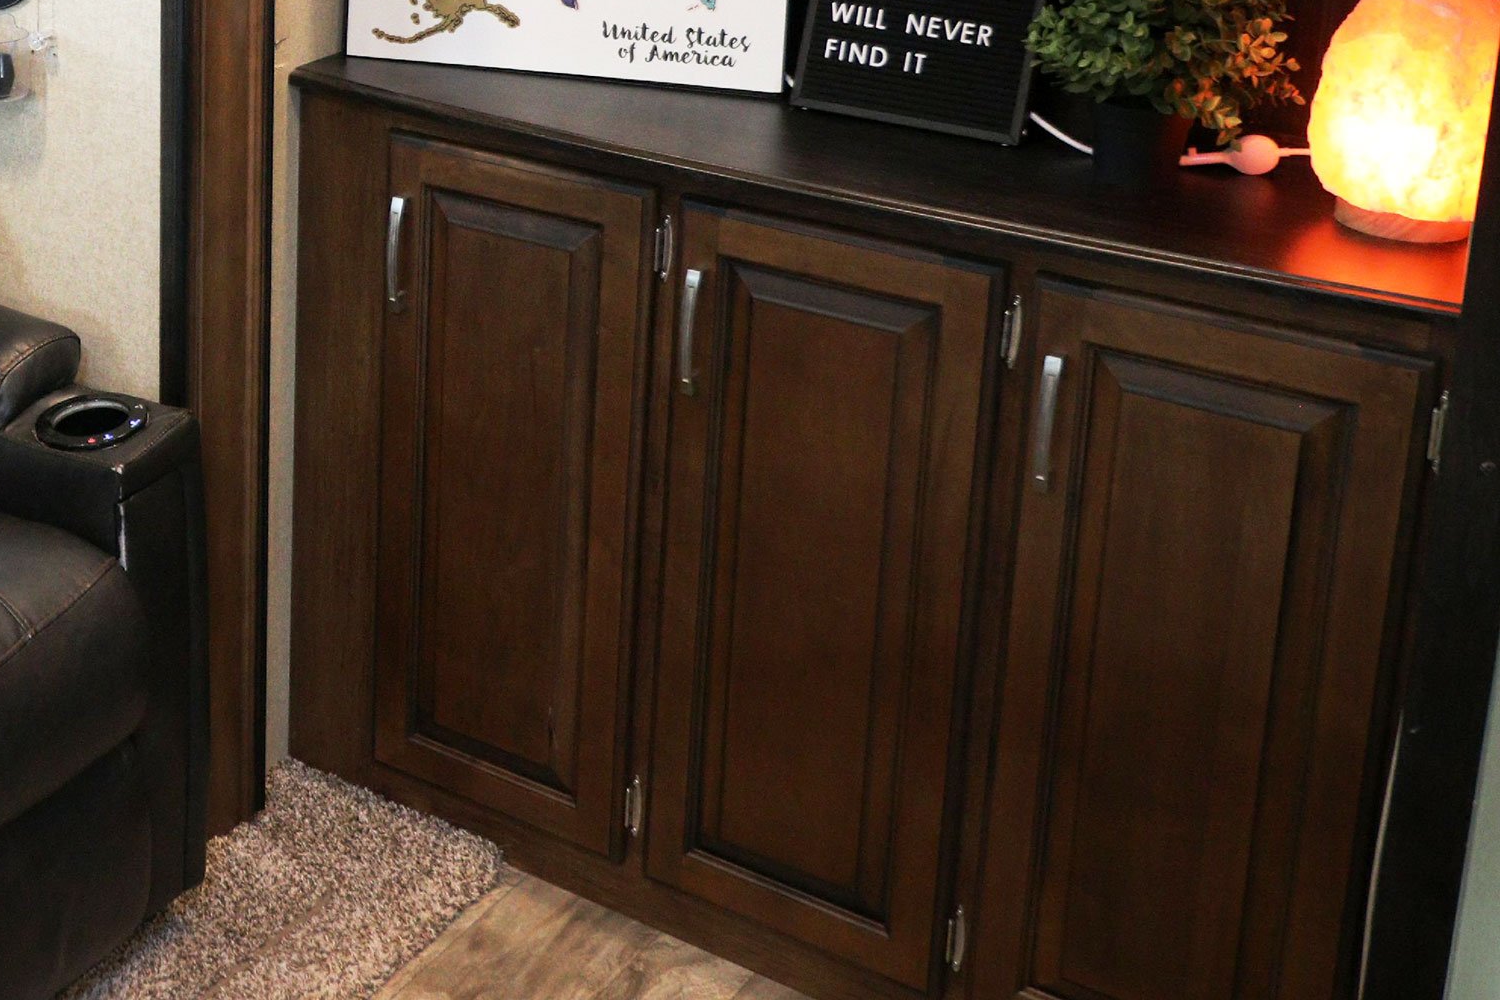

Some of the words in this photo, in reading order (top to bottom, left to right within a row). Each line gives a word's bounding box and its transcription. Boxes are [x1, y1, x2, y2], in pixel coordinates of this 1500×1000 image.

[602, 20, 677, 44] United
[685, 27, 751, 52] States
[831, 2, 886, 30] WILL
[905, 14, 993, 47] NEVER
[618, 42, 636, 63] of
[645, 44, 737, 67] America
[824, 39, 889, 68] FIND
[903, 52, 927, 74] IT
